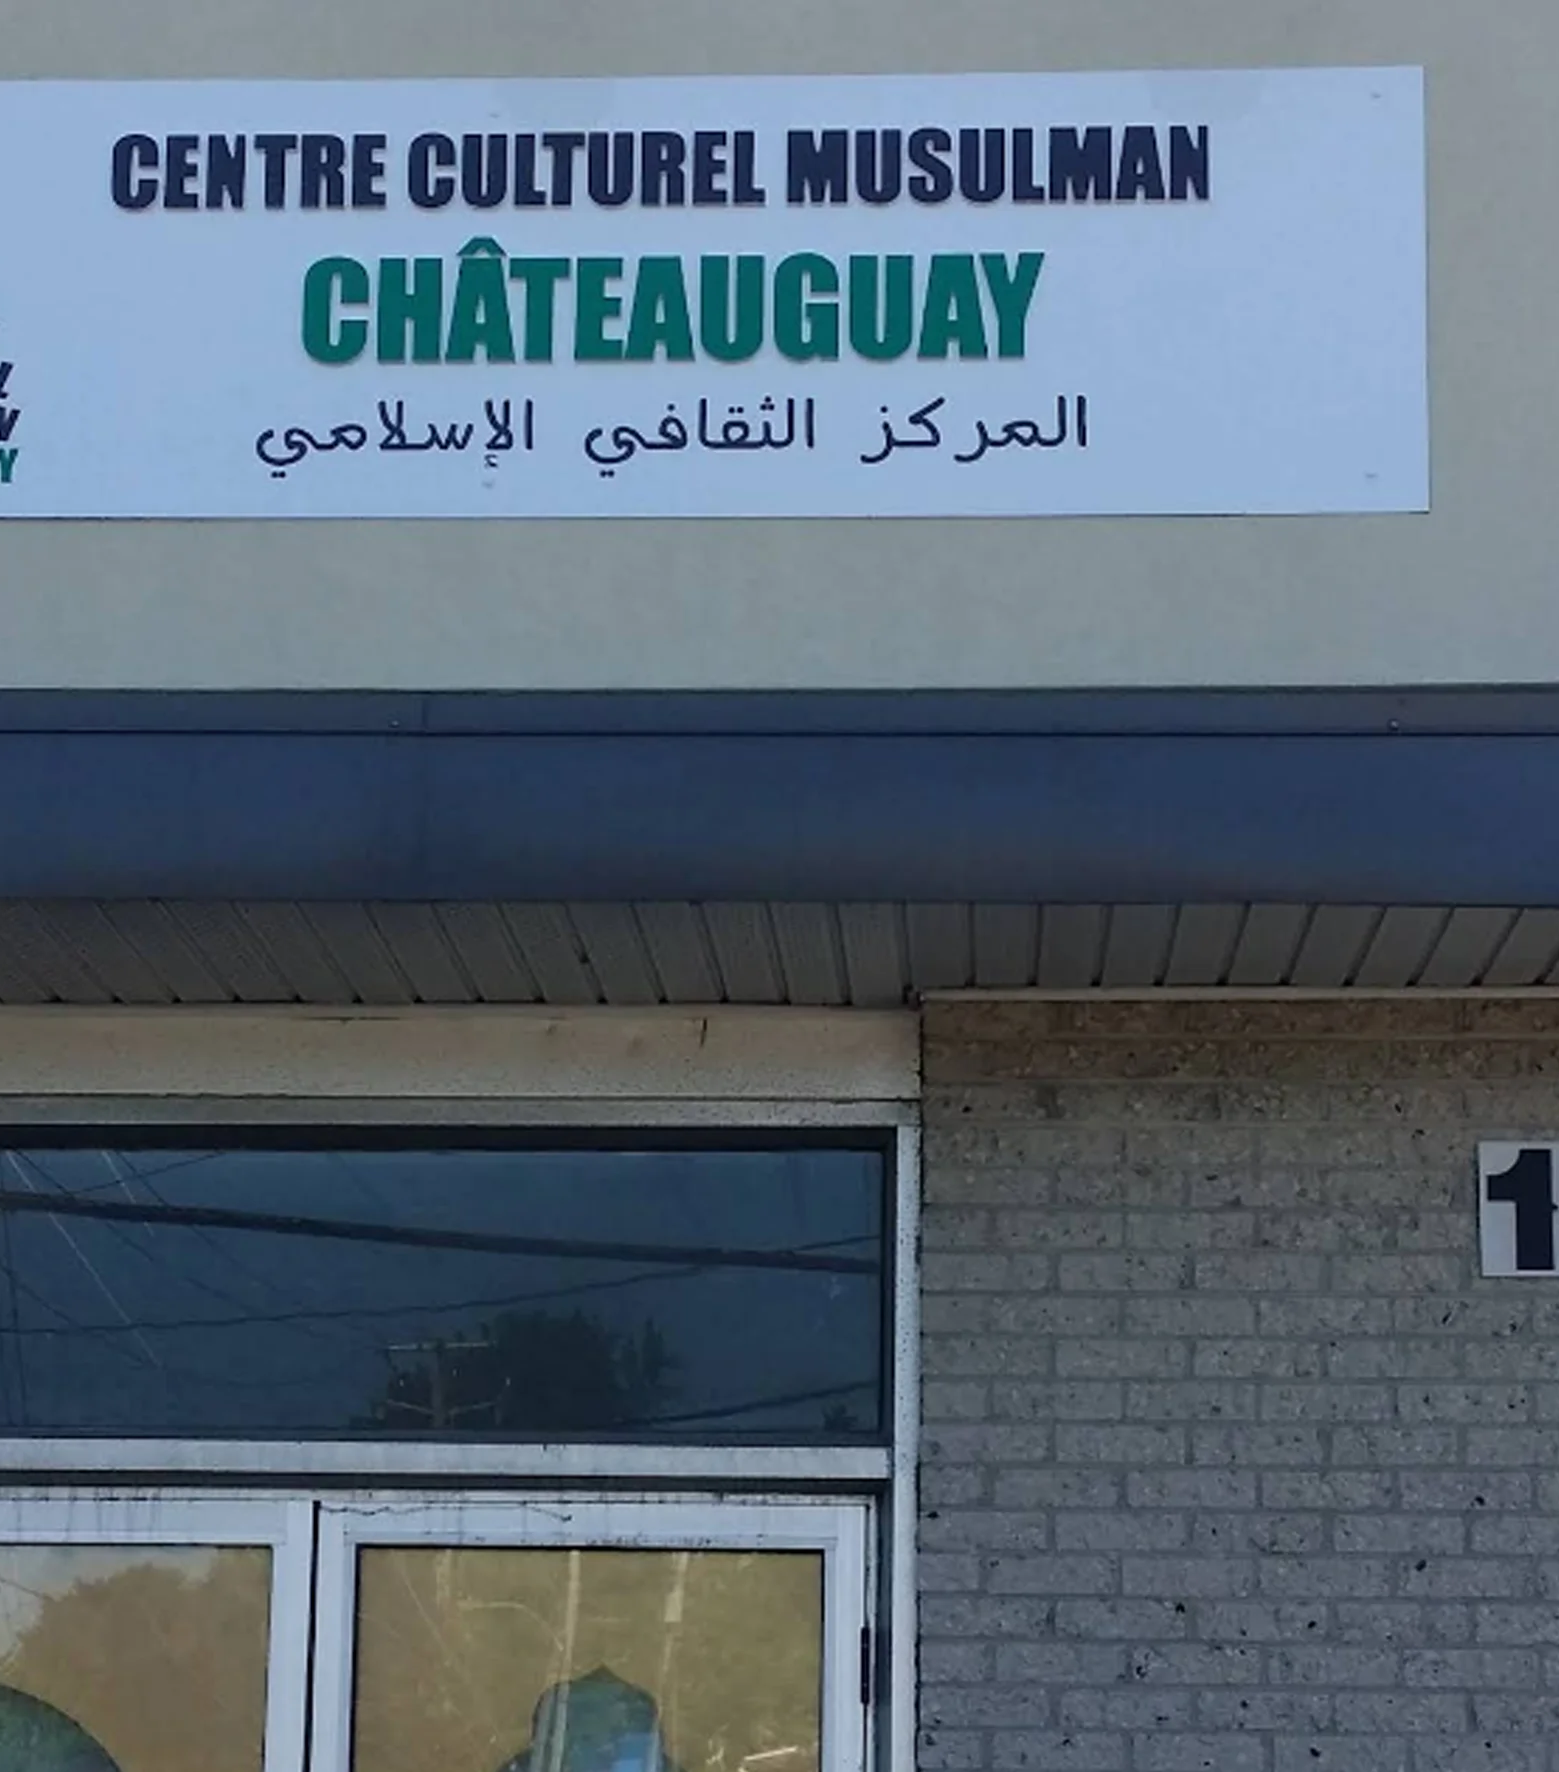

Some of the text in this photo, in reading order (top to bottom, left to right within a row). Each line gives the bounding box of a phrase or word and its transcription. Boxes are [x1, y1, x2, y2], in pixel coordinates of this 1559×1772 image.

[111, 125, 1210, 212] CENTRE CULTUREL MUSULMAN
[300, 236, 1046, 367] CHÂTEAUGUAY
[255, 394, 1088, 479] المركز الثقافي الإسلامي
